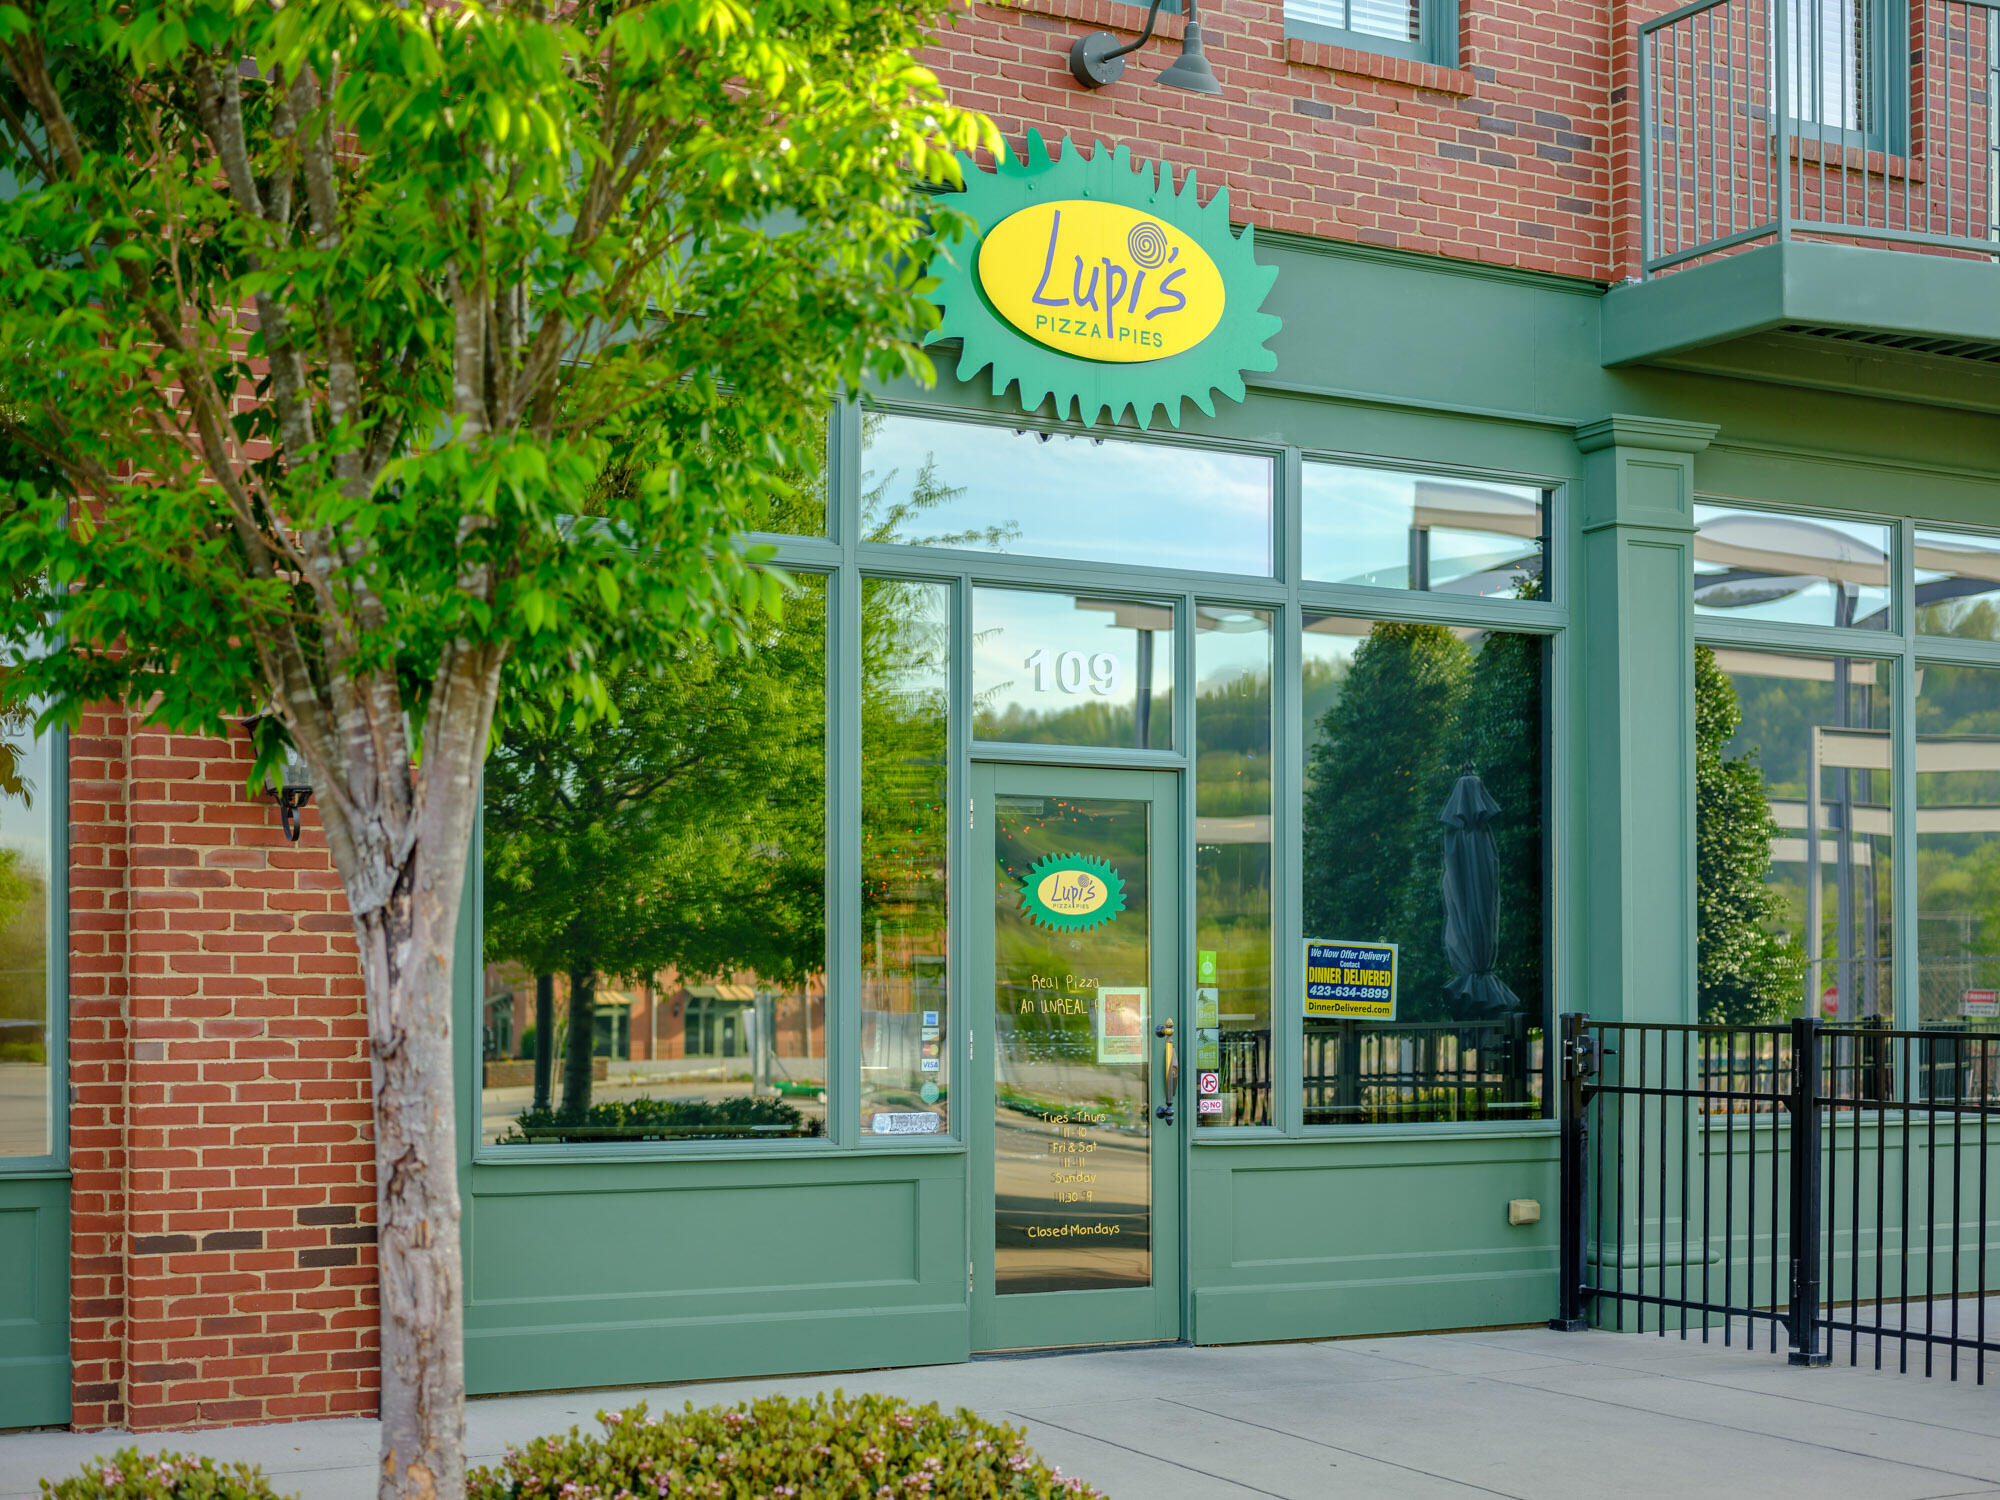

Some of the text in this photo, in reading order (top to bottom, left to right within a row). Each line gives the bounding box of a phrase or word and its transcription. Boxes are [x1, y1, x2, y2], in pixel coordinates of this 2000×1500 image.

[1032, 210, 1187, 339] Lupi's
[1036, 314, 1164, 349] PIZZA PIES
[1024, 648, 1120, 696] 109
[1051, 874, 1096, 908] Lupi's
[1310, 948, 1391, 962] We Now Offer Delivery!
[1031, 975, 1100, 991] Real Pizza
[1308, 966, 1391, 987] DINNER DELIVERED
[1309, 985, 1389, 999] 423-634-8899
[1021, 999, 1034, 1015] An
[1040, 999, 1088, 1015] UNREAL
[1308, 1002, 1390, 1014] DinnerDelivered.com
[1210, 1101, 1221, 1109] NO
[1042, 1112, 1069, 1124] Tues
[1077, 1111, 1106, 1122] Thurs
[1053, 1141, 1096, 1153] Fri & Sat
[1055, 1171, 1096, 1184] Sunday
[1027, 1222, 1120, 1238] Closed Mondays
